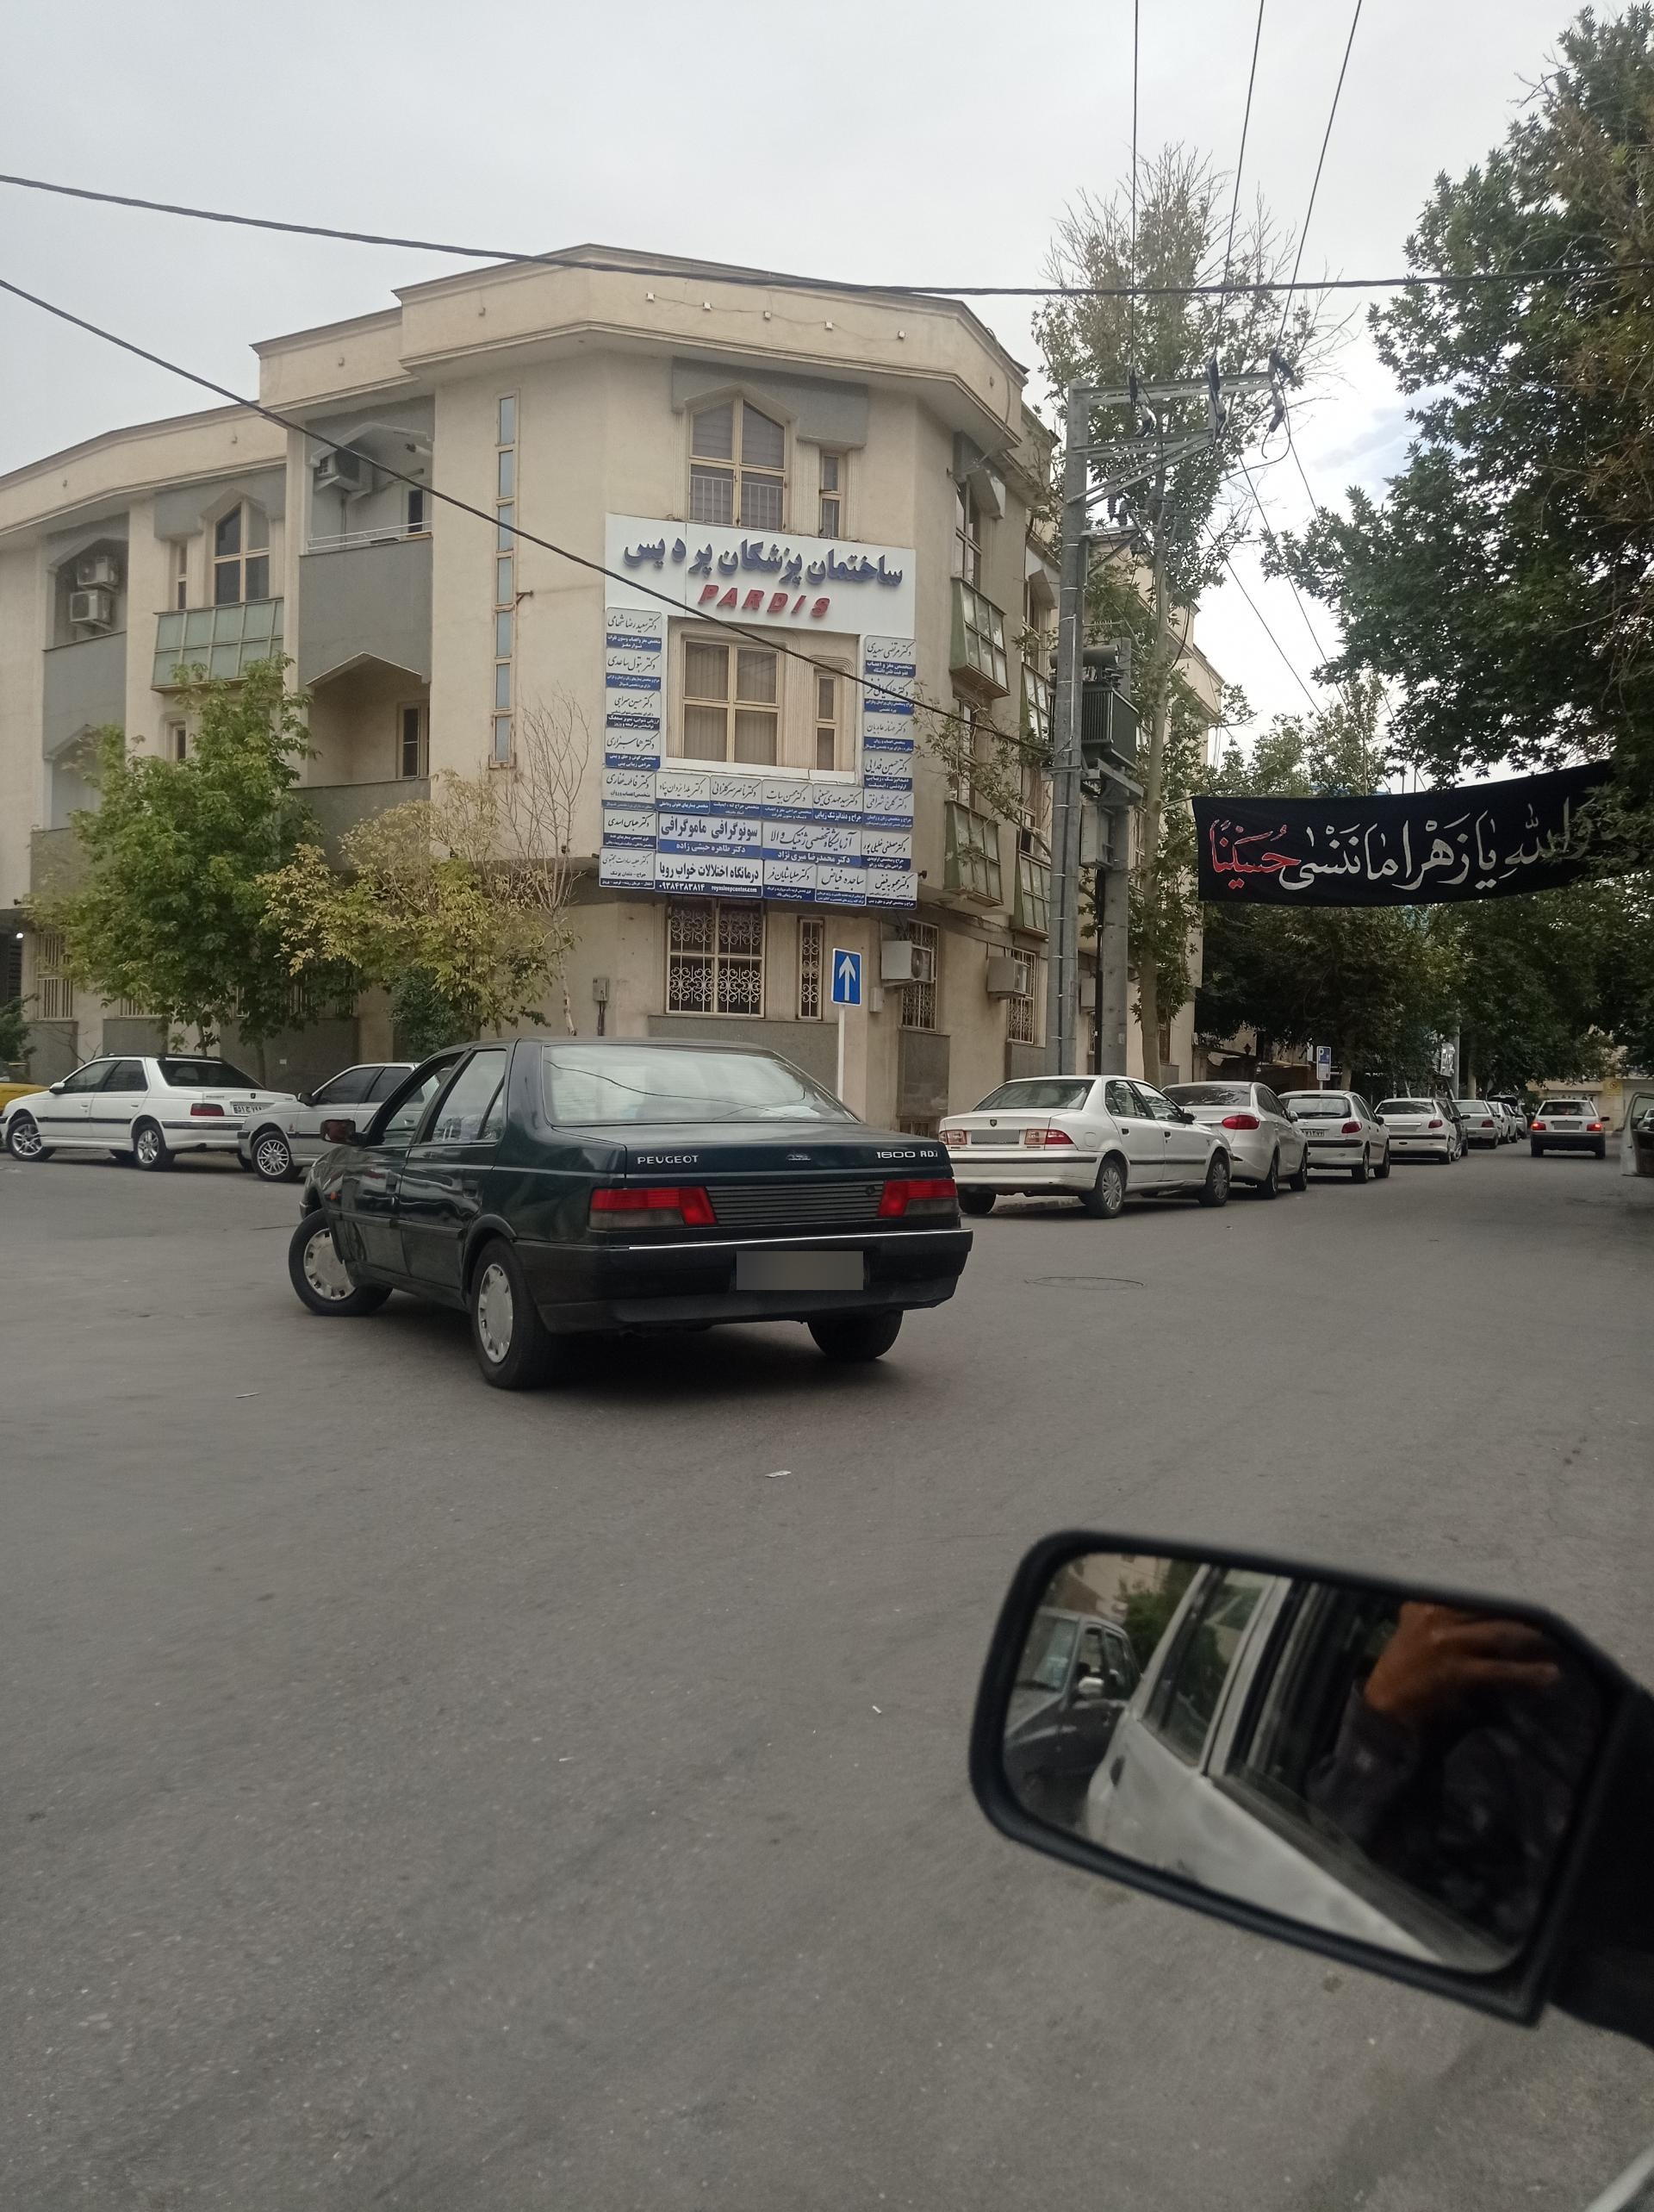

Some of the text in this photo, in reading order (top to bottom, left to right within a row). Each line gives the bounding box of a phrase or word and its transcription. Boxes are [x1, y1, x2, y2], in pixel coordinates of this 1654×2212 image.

[718, 539, 803, 587] پزشکان
[805, 548, 903, 587] ساختمان
[698, 584, 830, 617] PARDIS
[644, 614, 662, 632] دکتر
[899, 642, 915, 657] دکتر
[641, 654, 660, 672] دکتر
[643, 692, 655, 708] دکتر
[895, 721, 907, 735] دکتر
[640, 731, 660, 751] دکتر
[894, 757, 911, 776] دکتر
[637, 772, 655, 789] دکتر
[690, 777, 706, 796] دکتر
[743, 782, 761, 799] دکتر
[792, 785, 809, 804] دکتر
[845, 791, 861, 807] دکتر
[894, 794, 911, 811] دکتر
[624, 819, 638, 831] عباس
[638, 813, 654, 827] دکتر
[661, 815, 758, 841] سونوگرافی ماموگرافی
[676, 842, 689, 851] زاده
[712, 843, 730, 853] طاهره
[731, 845, 746, 854] دکتر
[895, 837, 909, 853] دکتر
[639, 852, 652, 865] دکتر
[836, 856, 850, 864] دکتر
[660, 862, 759, 883] درمانگاه اختلالات خواب رویا
[797, 865, 813, 882] دکتر
[896, 874, 914, 890] دکتر
[637, 1155, 699, 1164] PEUGEOT
[876, 1150, 916, 1159] 1600
